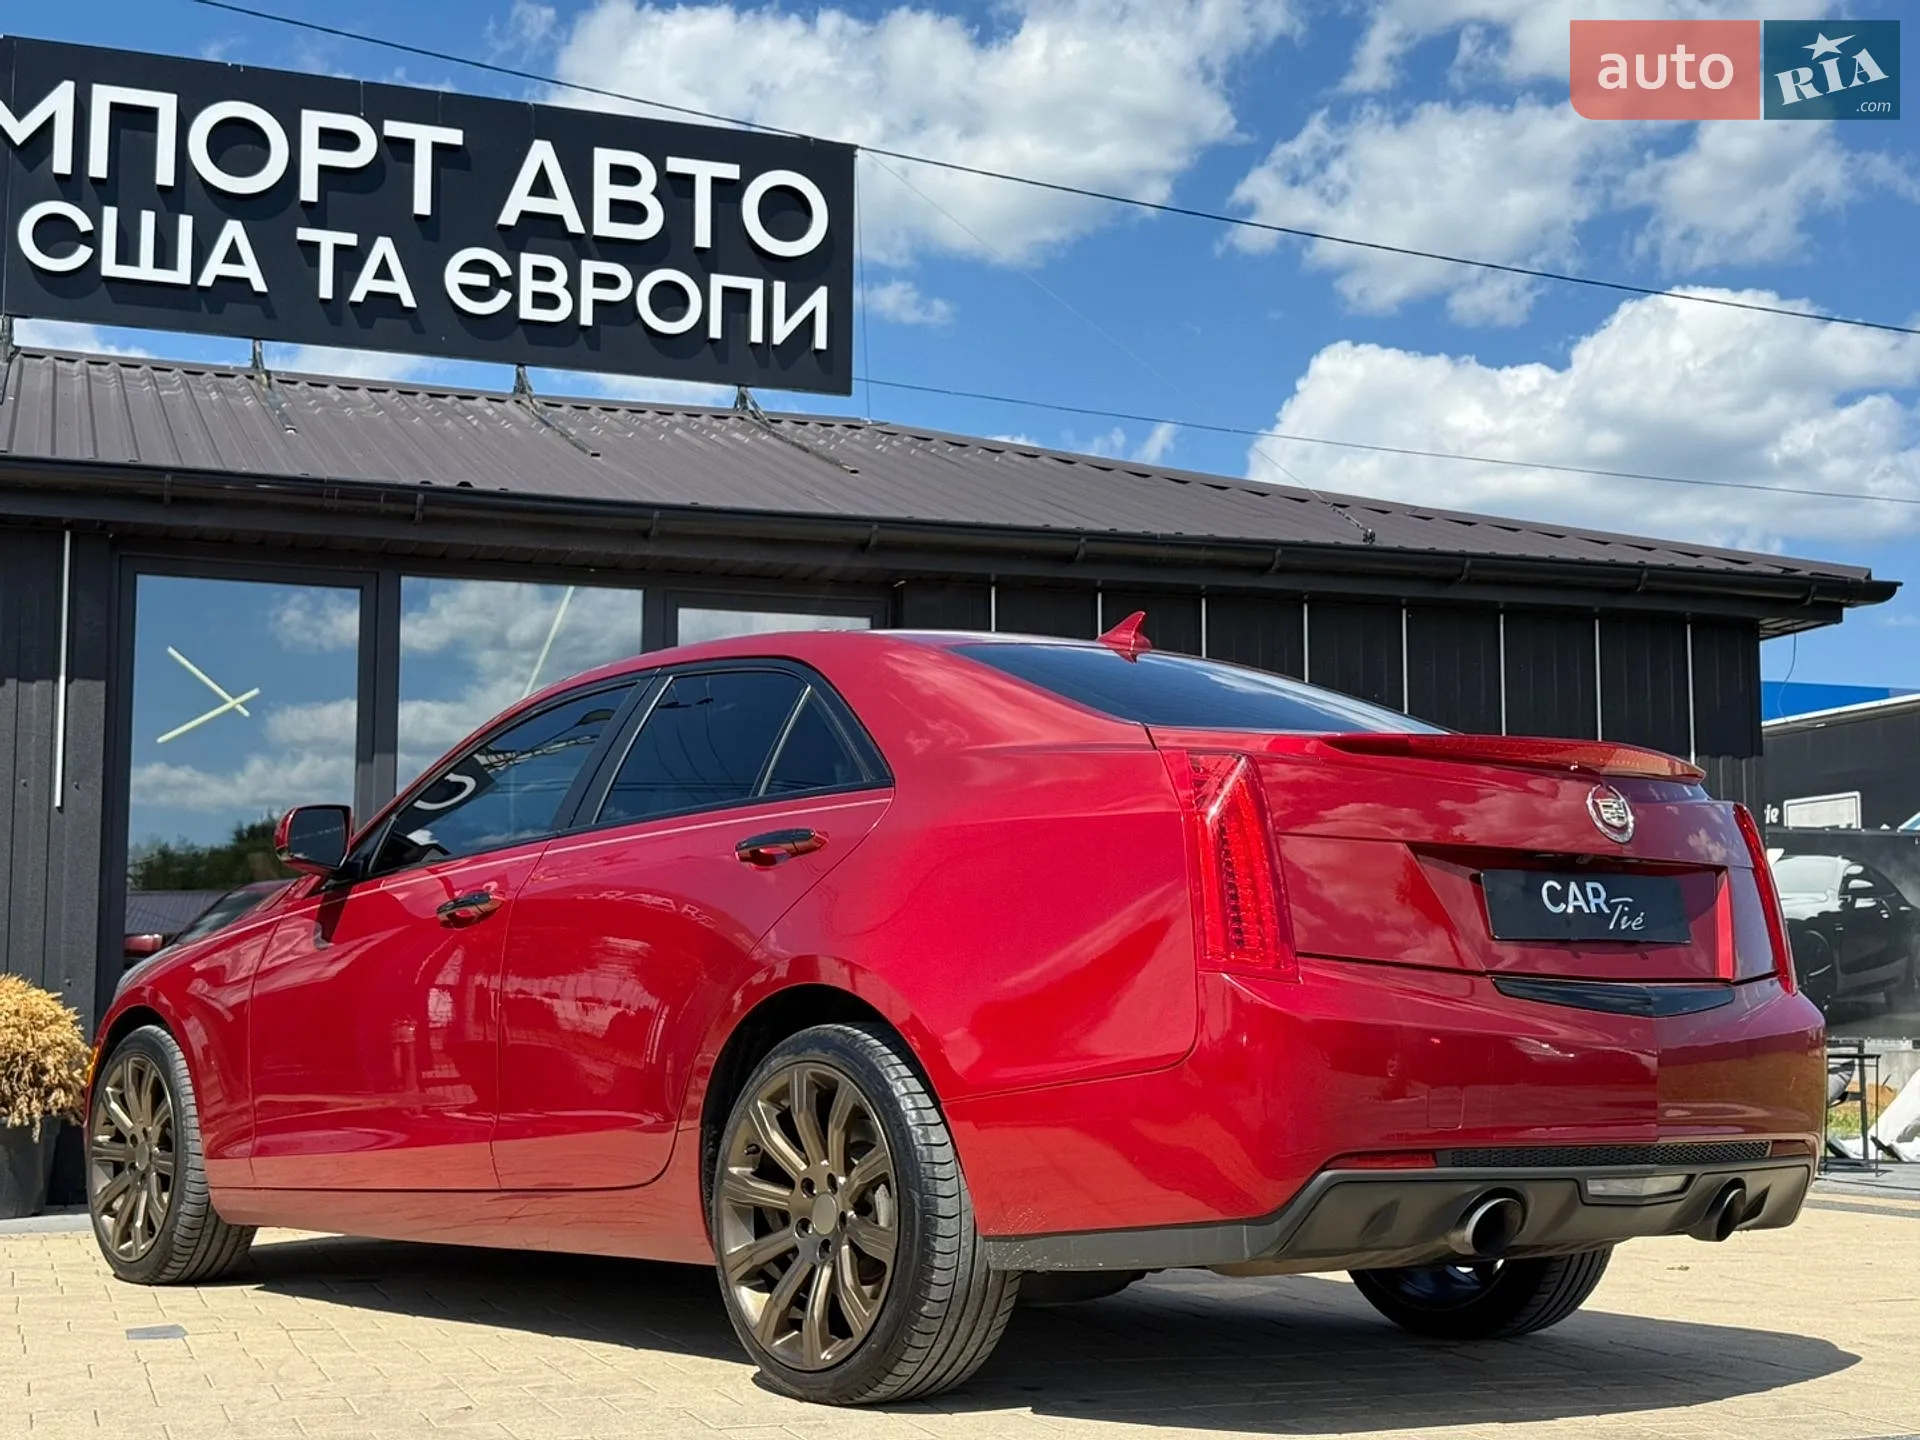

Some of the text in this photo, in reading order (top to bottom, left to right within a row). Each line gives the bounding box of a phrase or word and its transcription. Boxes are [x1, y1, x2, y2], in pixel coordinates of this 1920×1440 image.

[497, 138, 830, 258] АВТО
[17, 200, 829, 351] США ТА ЄВРОПИ
[1541, 879, 1611, 914] CAR
